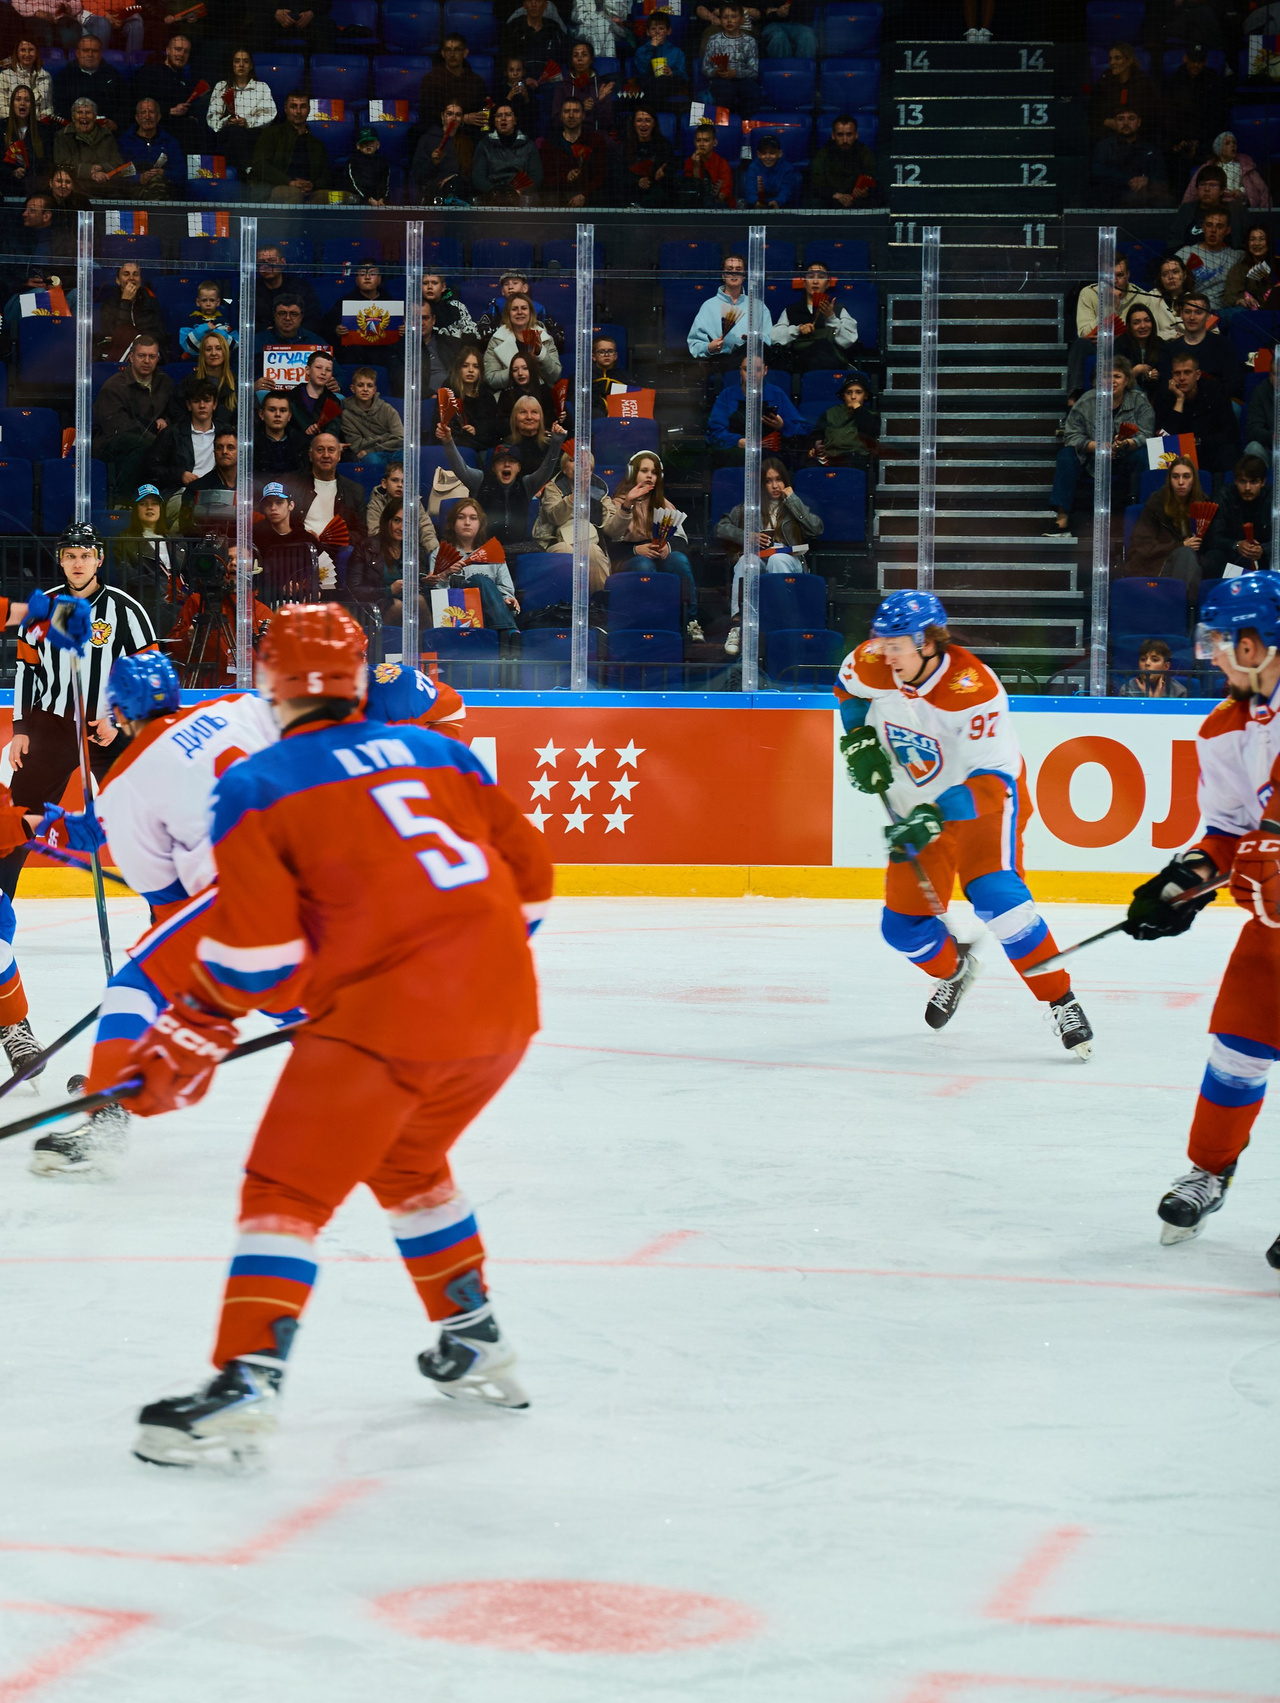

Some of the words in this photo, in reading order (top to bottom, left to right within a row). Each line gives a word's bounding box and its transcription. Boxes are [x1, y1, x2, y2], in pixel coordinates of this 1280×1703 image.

[904, 50, 930, 70] 14
[1018, 49, 1045, 70] 14
[896, 104, 924, 125] 13
[1021, 103, 1049, 125] 13
[893, 164, 921, 185] 12
[1020, 163, 1048, 185] 12
[894, 222, 916, 243] 11
[1022, 223, 1046, 247] 11
[267, 352, 311, 366] СТУДЕ
[307, 671, 324, 694] 5
[171, 714, 229, 759] ДИЛЬ
[969, 711, 1000, 741] 97
[368, 779, 489, 891] 5
[1237, 839, 1280, 854] CC
[154, 1013, 230, 1063] CCM
